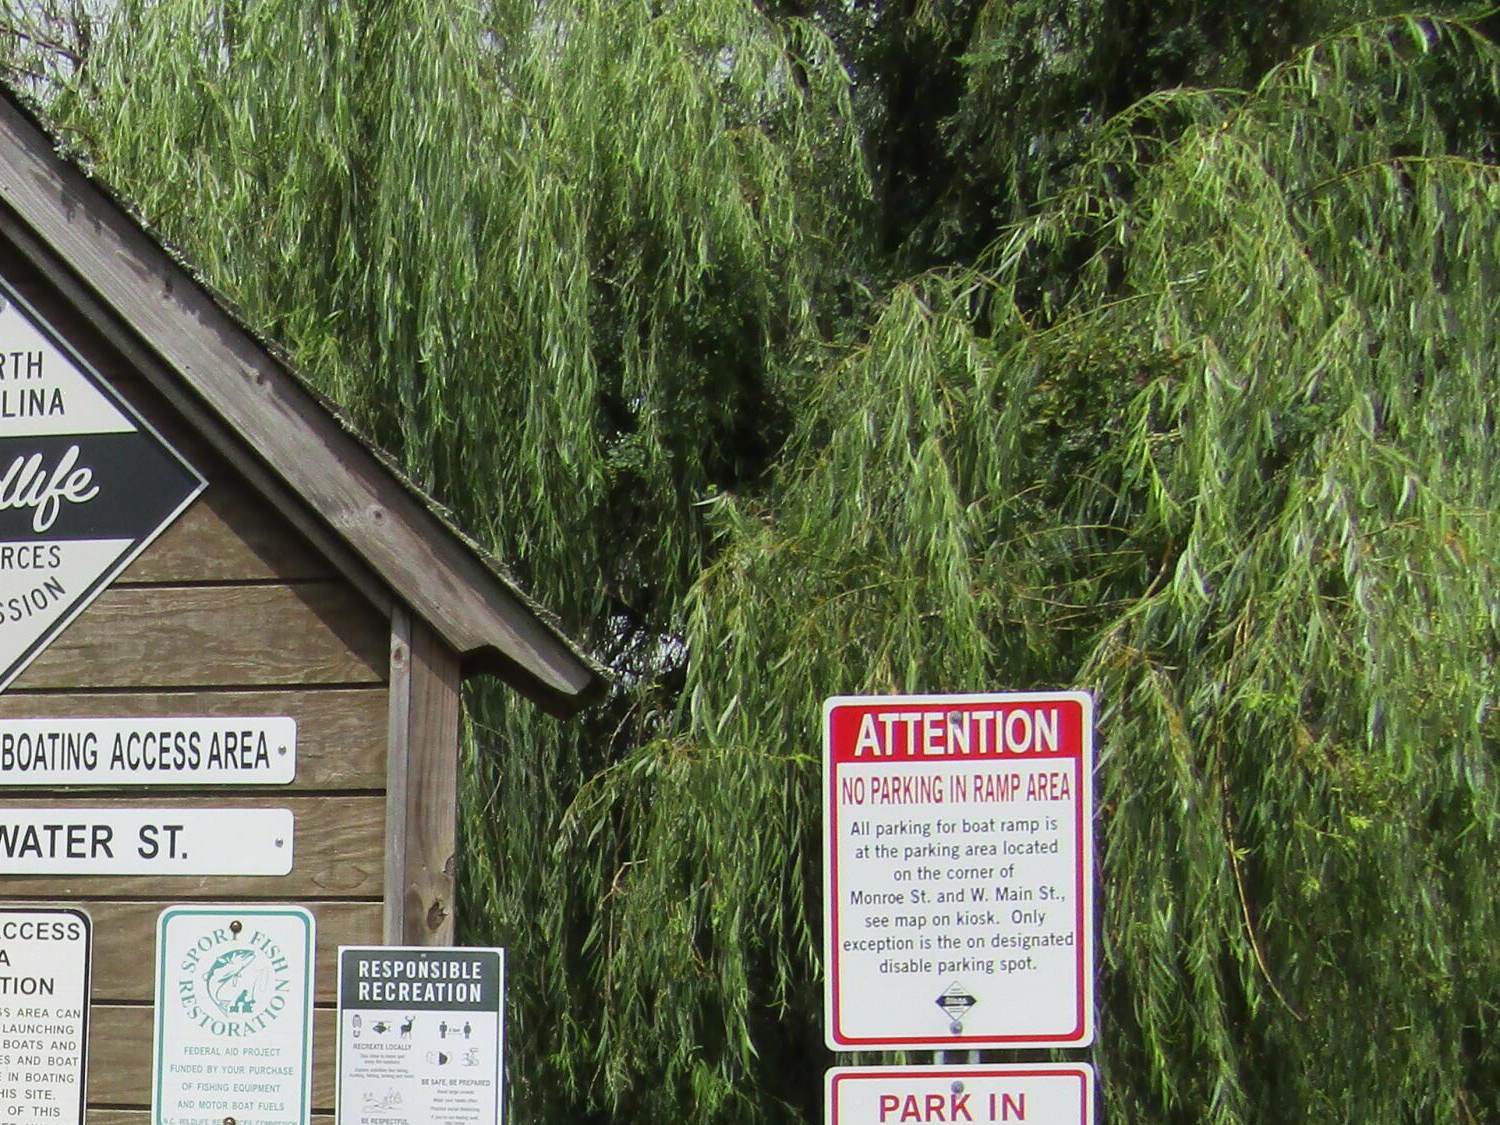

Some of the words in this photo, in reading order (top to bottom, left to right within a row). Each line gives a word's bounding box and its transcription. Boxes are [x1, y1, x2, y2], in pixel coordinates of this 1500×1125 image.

[854, 709, 1057, 756] ATTENTION
[1, 732, 97, 771] BOATING
[110, 731, 200, 770] ACCESS
[208, 731, 270, 769] AREA
[843, 777, 865, 805] NO
[871, 776, 943, 804] PARKING
[950, 775, 966, 803] IN
[974, 774, 1020, 802] RAMP
[1027, 772, 1070, 800] AREA
[851, 821, 869, 835] All
[876, 820, 930, 837] parking
[937, 820, 956, 834] for
[963, 818, 994, 833] boat
[1001, 818, 1039, 834] ramp
[1046, 816, 1057, 830] is
[138, 825, 187, 859] ST.
[855, 845, 869, 859] at
[876, 845, 898, 858] the
[904, 843, 959, 860] parking
[966, 843, 997, 856] area
[1004, 840, 1057, 855] located
[894, 868, 911, 881] on
[918, 866, 940, 880] the
[947, 866, 993, 879] corner
[1000, 865, 1014, 878] of
[851, 891, 904, 905] Monroe
[911, 890, 931, 903] St.
[937, 889, 964, 902] and
[971, 888, 988, 901] W.
[996, 887, 1032, 900] Main
[865, 915, 889, 927] see
[895, 914, 926, 929] map
[933, 913, 950, 926] on
[957, 911, 1000, 925] kiosk.
[1012, 909, 1045, 926] Only
[844, 937, 912, 953] exception
[920, 936, 931, 949] is
[937, 935, 960, 949] the
[967, 935, 985, 948] on
[991, 932, 1073, 951] designated
[250, 931, 289, 975] FISH
[359, 960, 481, 979] RESPONSIBLE
[880, 959, 932, 973] disable
[938, 957, 993, 975] parking
[1000, 957, 1036, 973] spot.
[359, 982, 481, 1002] RECREATION
[179, 977, 290, 1037] RESTORATION
[184, 1046, 220, 1056] FEDERAL
[225, 1047, 239, 1056] AID
[243, 1048, 280, 1057] PROJECT
[170, 1065, 203, 1073] FUNDED
[222, 1066, 244, 1074] YOUR
[249, 1067, 293, 1075] PURCHASE
[182, 1083, 193, 1091] OF
[197, 1083, 229, 1092] FISHING
[233, 1084, 280, 1093] EQUIPMENT
[178, 1100, 195, 1109] AND
[199, 1101, 227, 1109] MOTOR
[232, 1102, 254, 1111] BOAT
[258, 1102, 284, 1111] FUELS
[879, 1094, 972, 1122] PARK
[990, 1093, 1025, 1121] IN
